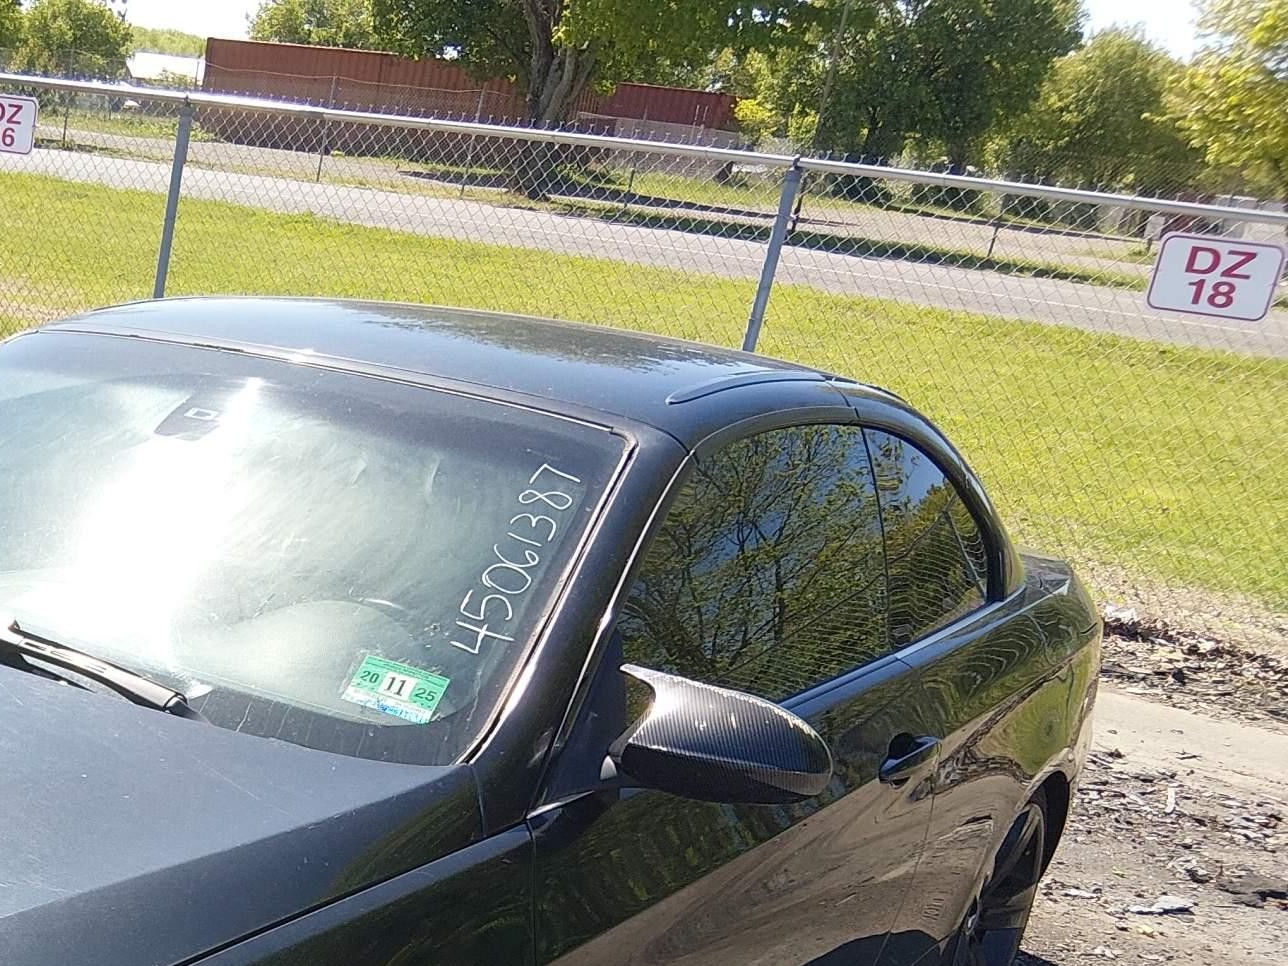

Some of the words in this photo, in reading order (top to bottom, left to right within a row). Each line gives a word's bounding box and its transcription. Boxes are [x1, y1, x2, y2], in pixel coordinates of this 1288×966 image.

[1184, 245, 1258, 280] DZ
[1188, 279, 1236, 309] 18
[449, 463, 581, 654] 45061387
[360, 670, 380, 684] 20
[384, 676, 407, 697] 11
[415, 687, 438, 702] 25
